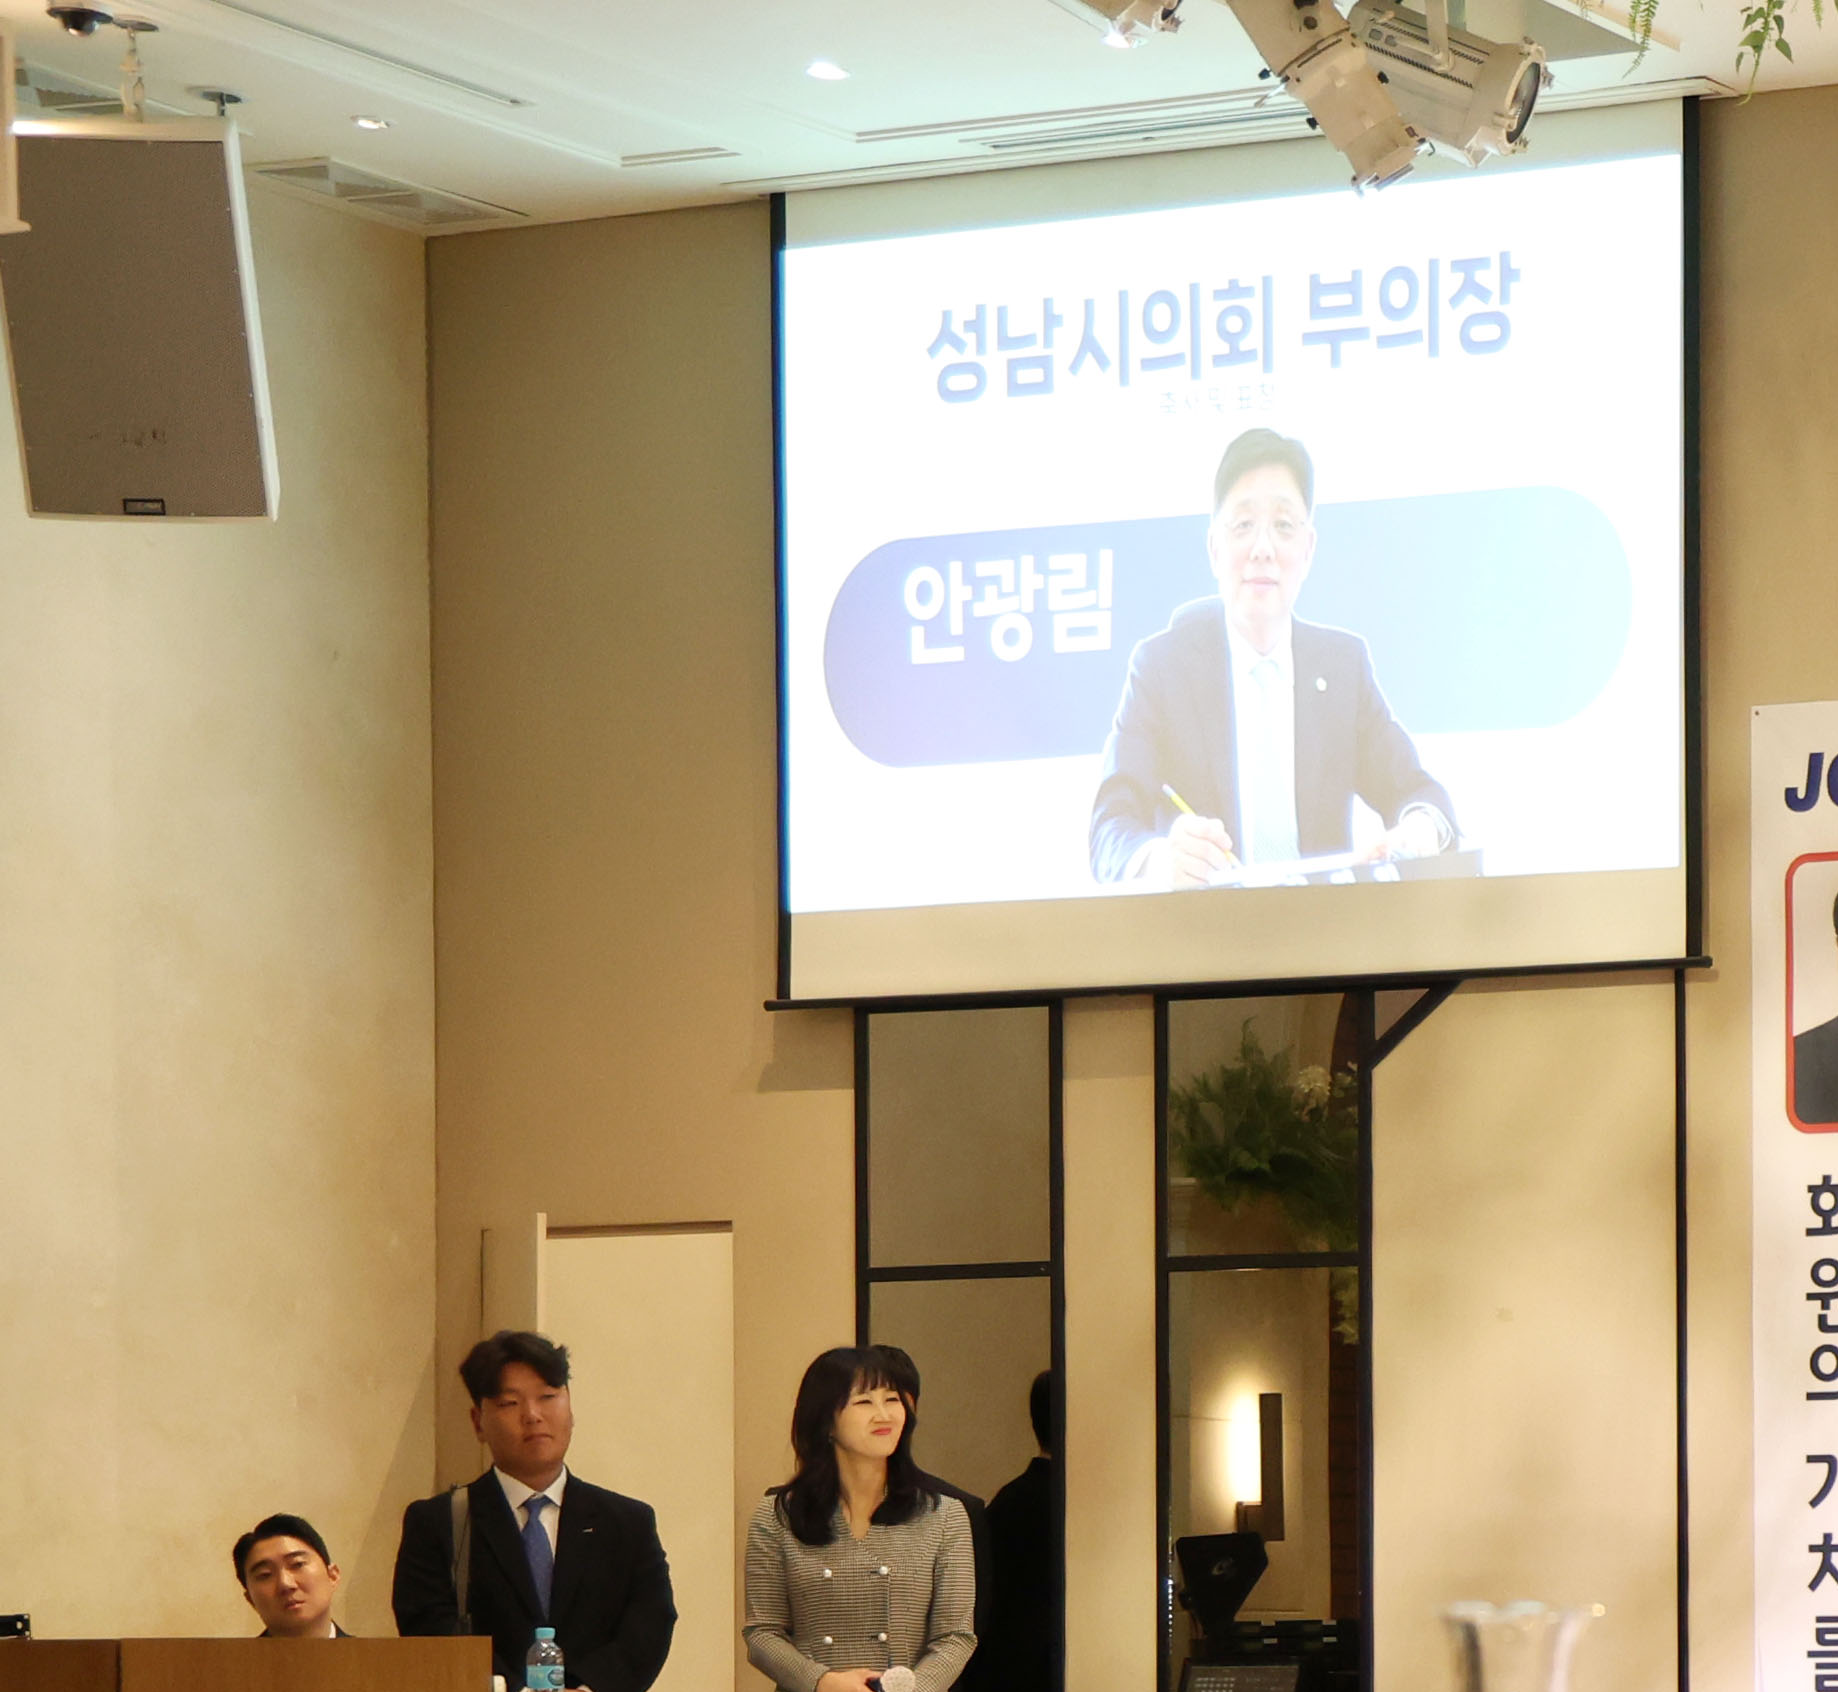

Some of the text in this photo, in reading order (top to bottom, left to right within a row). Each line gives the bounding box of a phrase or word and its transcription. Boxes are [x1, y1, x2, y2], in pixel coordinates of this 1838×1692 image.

[928, 251, 1521, 404] 성남시의회 부의장
[904, 548, 1113, 665] 안광림
